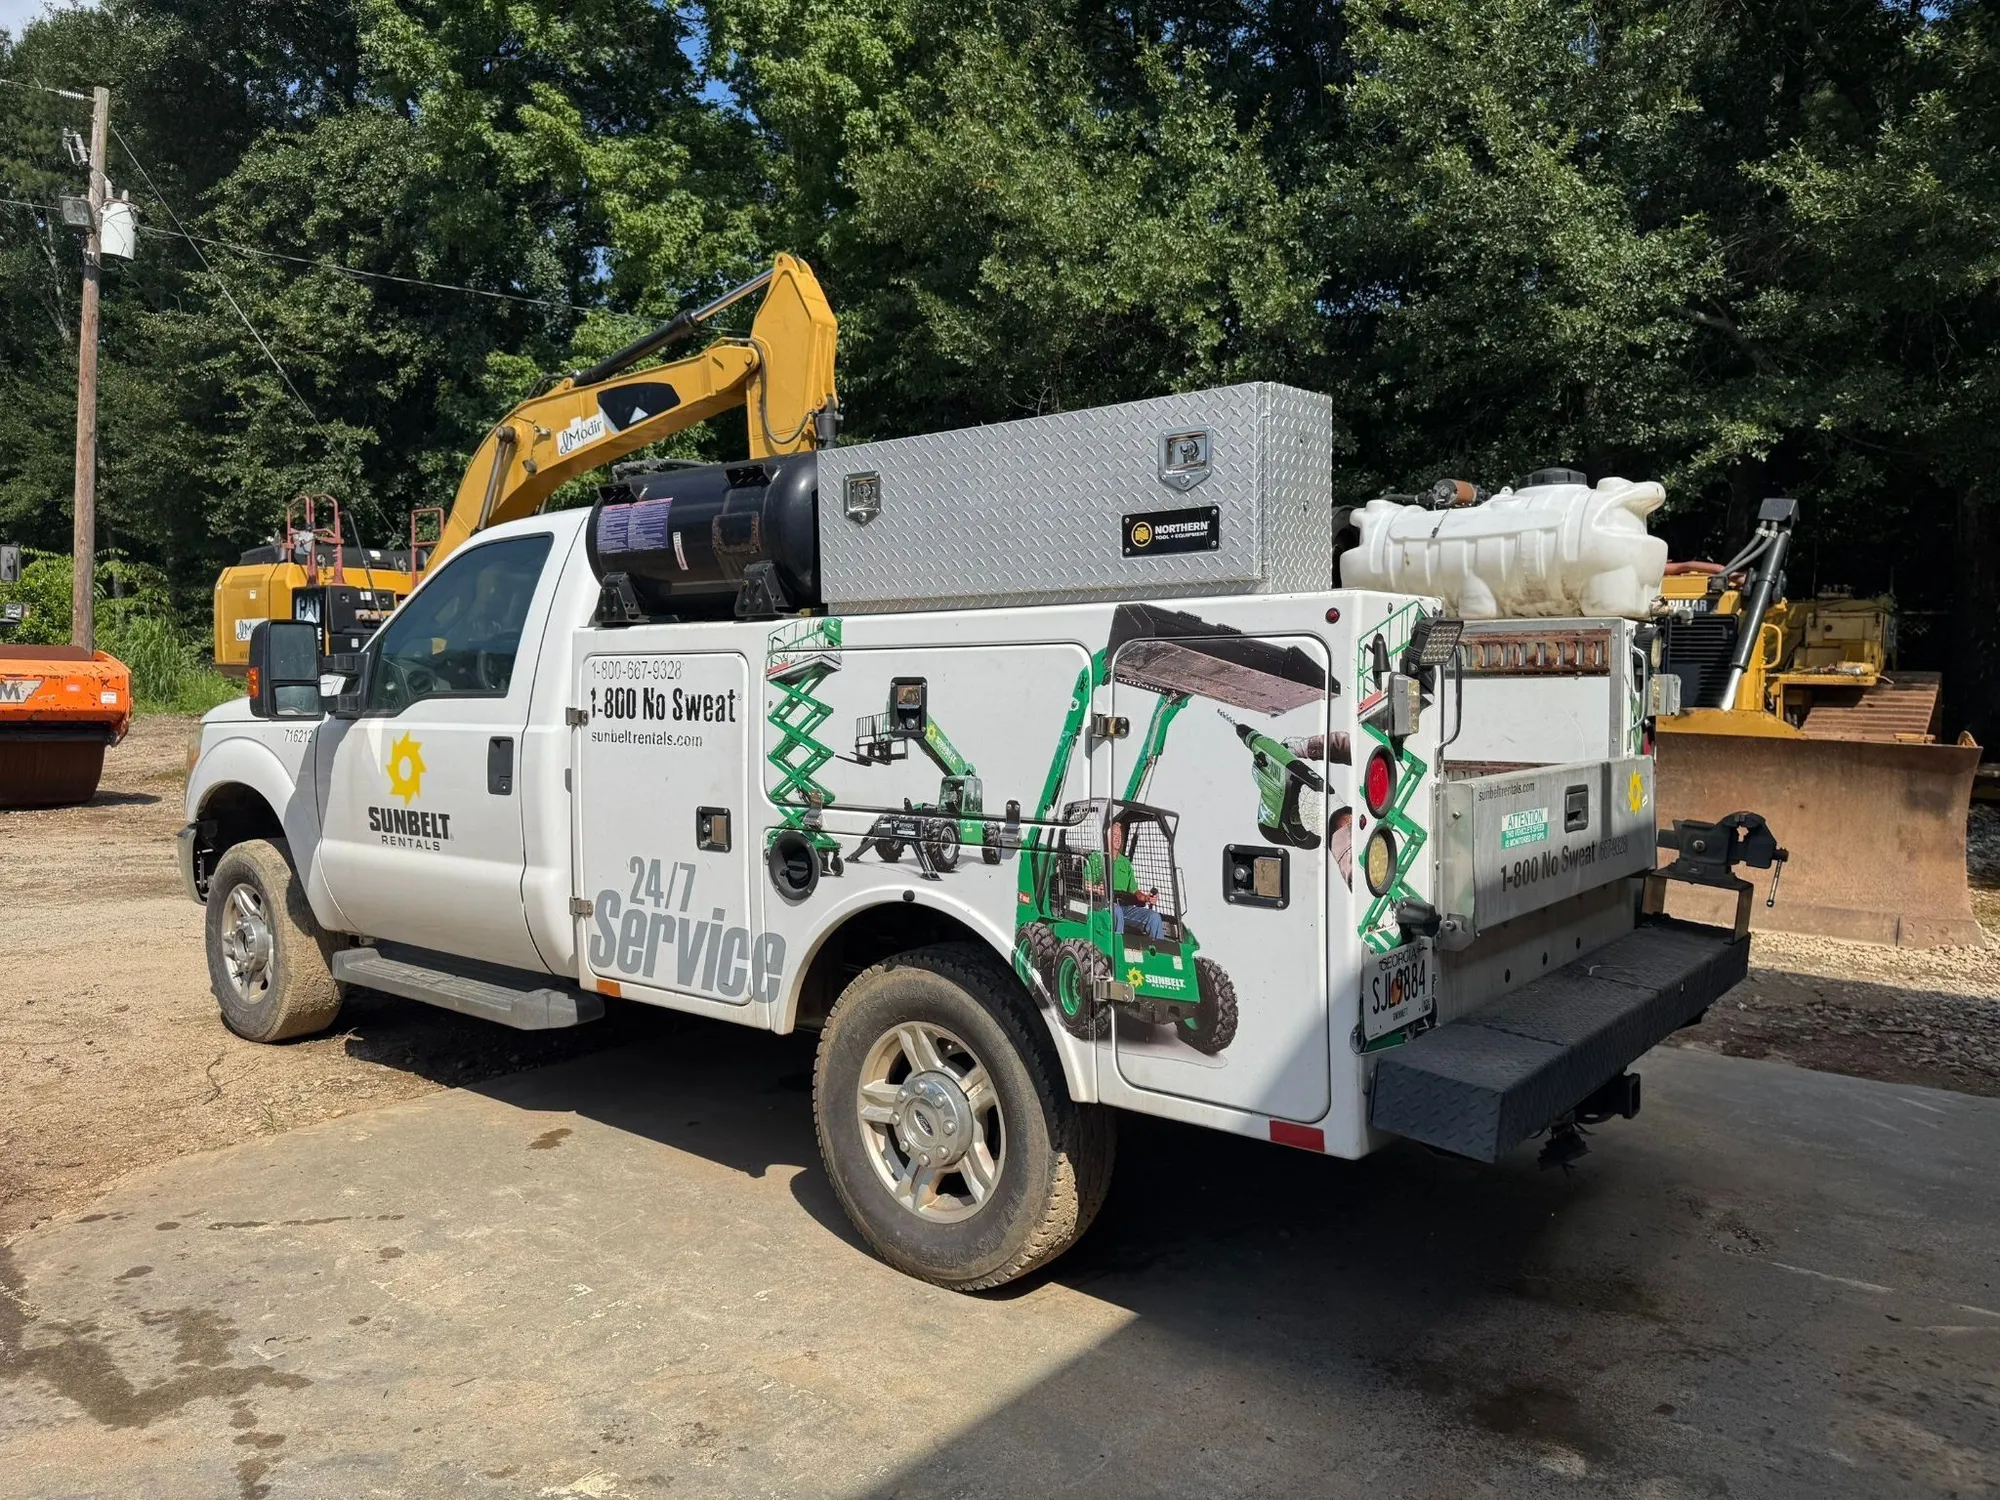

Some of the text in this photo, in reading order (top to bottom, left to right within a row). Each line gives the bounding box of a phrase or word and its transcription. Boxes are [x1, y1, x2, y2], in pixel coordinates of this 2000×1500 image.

[1155, 521, 1208, 534] NORTHERN
[1175, 531, 1208, 539] EQUIPMENT
[592, 661, 682, 680] 1-800-667-9328
[591, 687, 736, 722] 1-800 No Sweat
[284, 729, 313, 743] 716212
[592, 729, 703, 747] sunbeltrentals.com
[1478, 782, 1535, 802] sunbeltrentals.com
[368, 806, 450, 840] SUNBELT
[1508, 810, 1543, 829] ATTENTION
[381, 835, 440, 851] RENTALS
[1501, 857, 1539, 892] 1-800
[1542, 850, 1558, 880] No
[1561, 841, 1595, 872] Sweat
[629, 856, 696, 912] 24/7
[589, 889, 787, 1003] Service
[1379, 946, 1418, 971] GEORGIA
[1145, 974, 1185, 988] SUNBELT
[1372, 959, 1425, 1014] SJL9884
